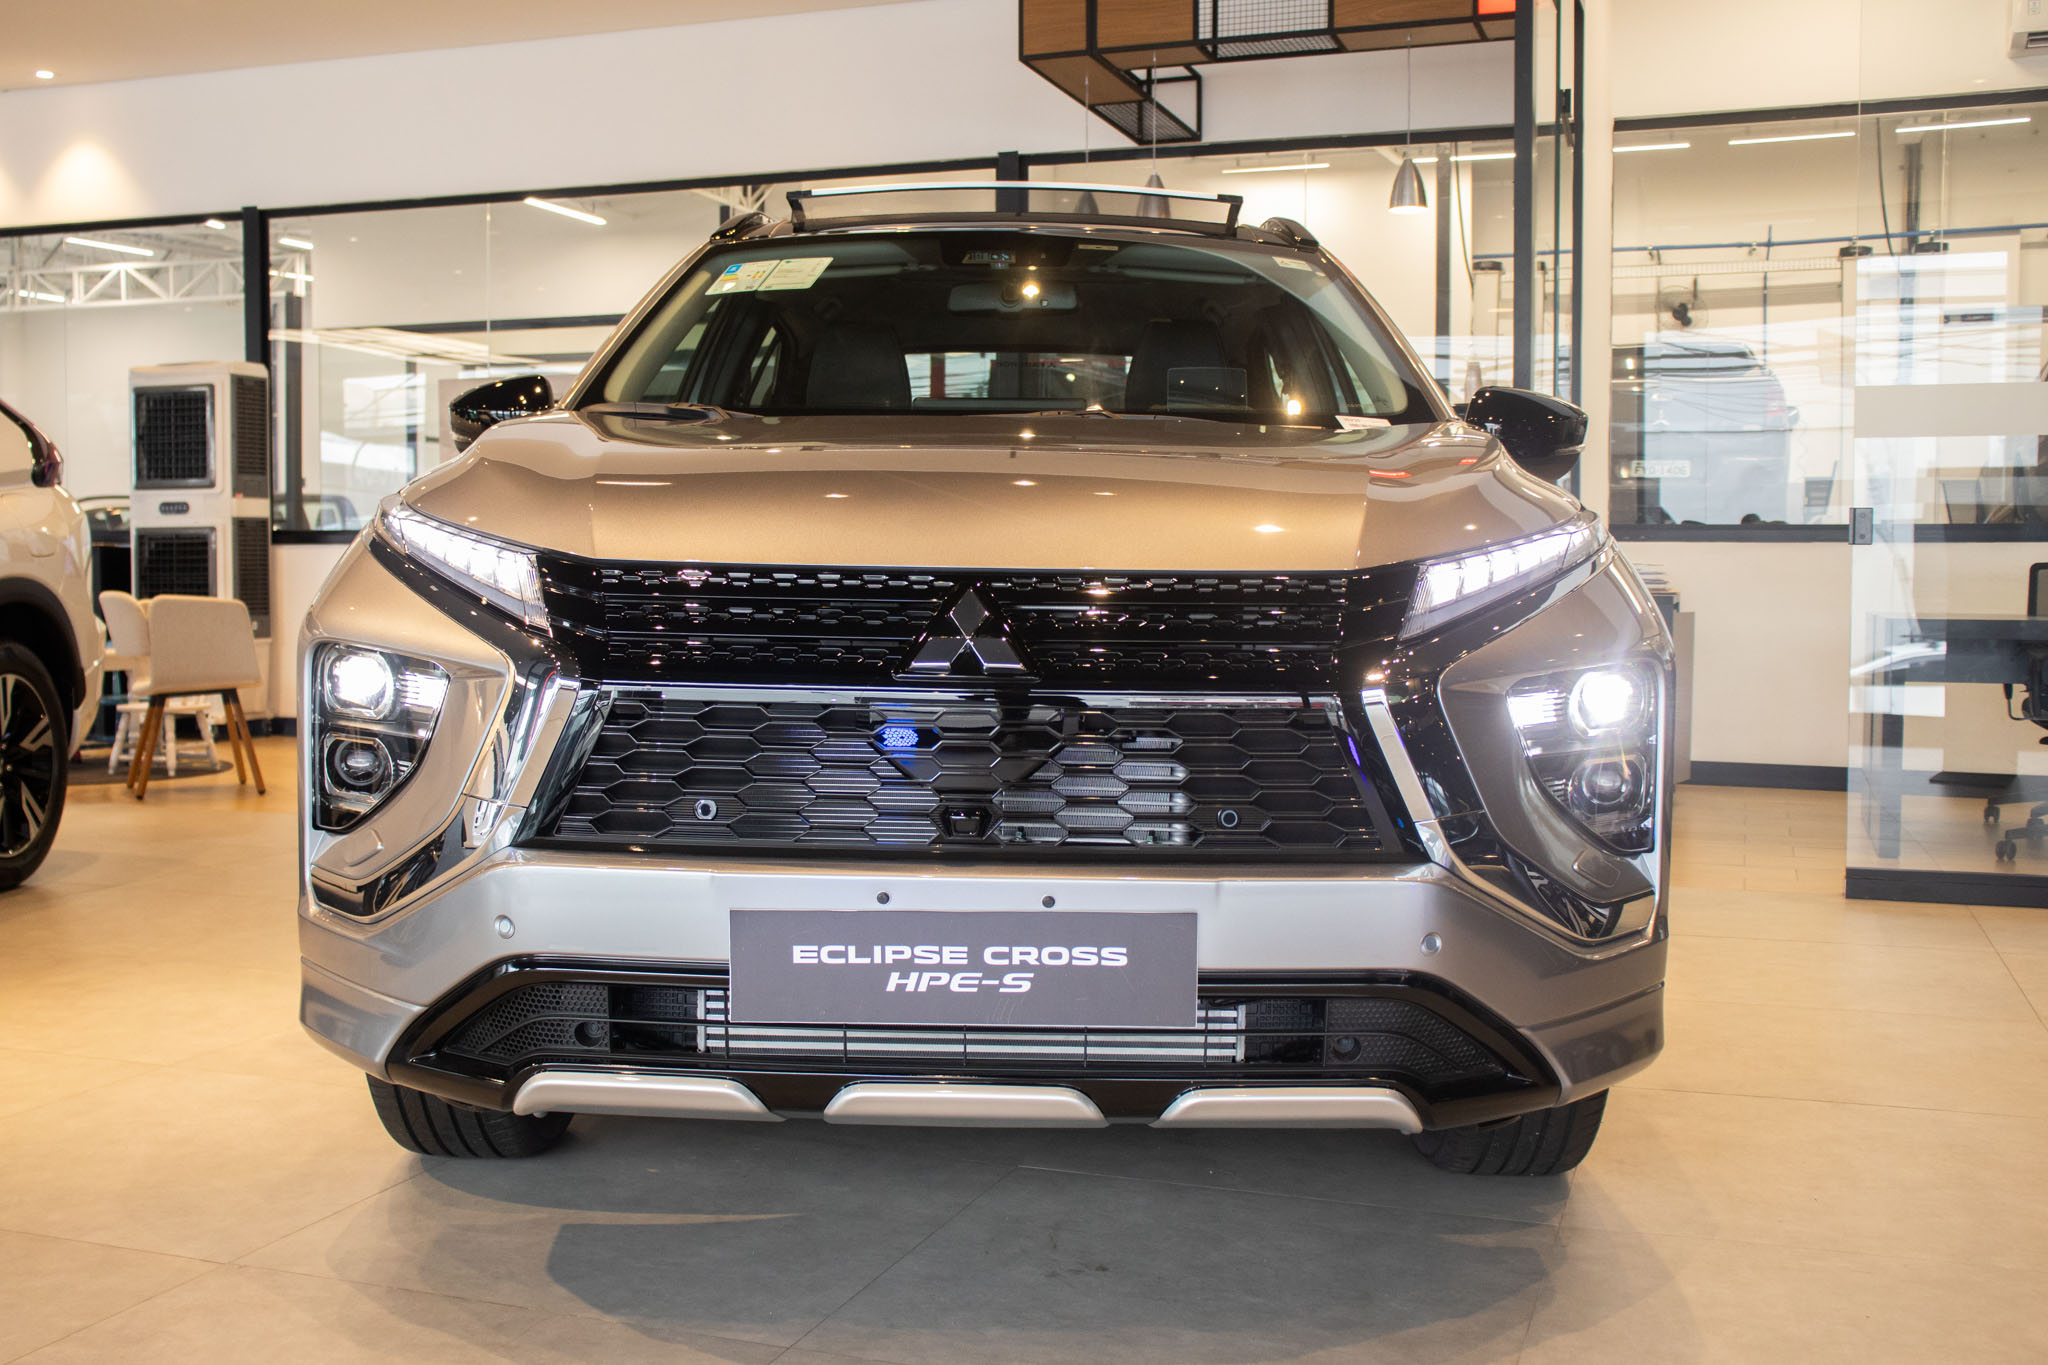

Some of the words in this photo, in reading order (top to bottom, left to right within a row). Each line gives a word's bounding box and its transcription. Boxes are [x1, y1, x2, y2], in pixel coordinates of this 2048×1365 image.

[792, 944, 969, 965] ECLIPSE
[983, 946, 1128, 966] CROSS
[885, 971, 1035, 993] HPE-S
